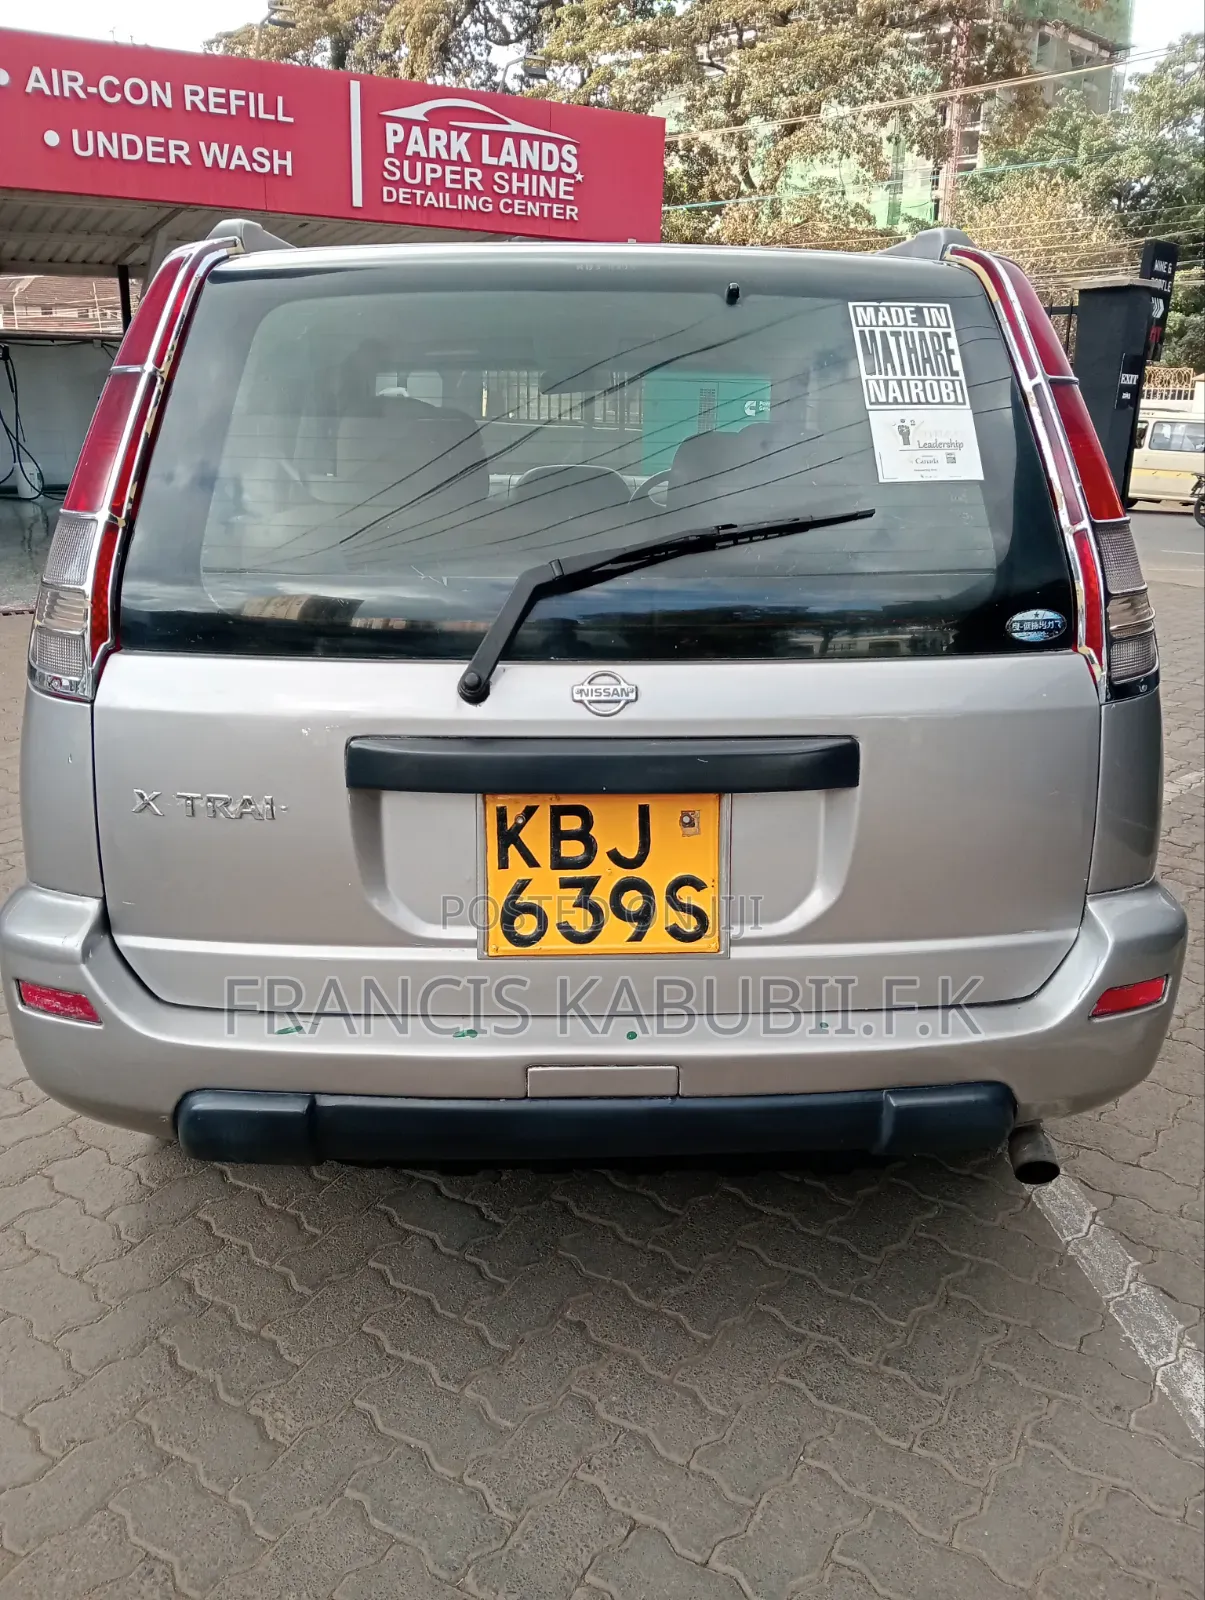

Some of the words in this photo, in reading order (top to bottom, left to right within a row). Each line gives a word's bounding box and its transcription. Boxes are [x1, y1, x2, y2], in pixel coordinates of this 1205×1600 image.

[25, 66, 173, 109] AIR-CON
[184, 84, 294, 123] REFILL
[72, 129, 191, 166] UNDER
[199, 141, 293, 176] WASH
[385, 122, 472, 163] PARK
[481, 134, 578, 174] LANDS
[383, 158, 484, 191] SUPER
[492, 171, 575, 200] SHINE
[382, 186, 493, 213] DETAILING
[499, 198, 579, 221] CENTER
[855, 306, 918, 327] MADE
[923, 307, 949, 327] IN
[867, 379, 964, 404] NAIROBI
[1121, 373, 1139, 385] EXIT
[917, 438, 964, 451] Leadership
[580, 687, 630, 698] NISSAN
[132, 788, 165, 816] X
[496, 803, 651, 870] KBJ
[499, 874, 710, 948] 639S
